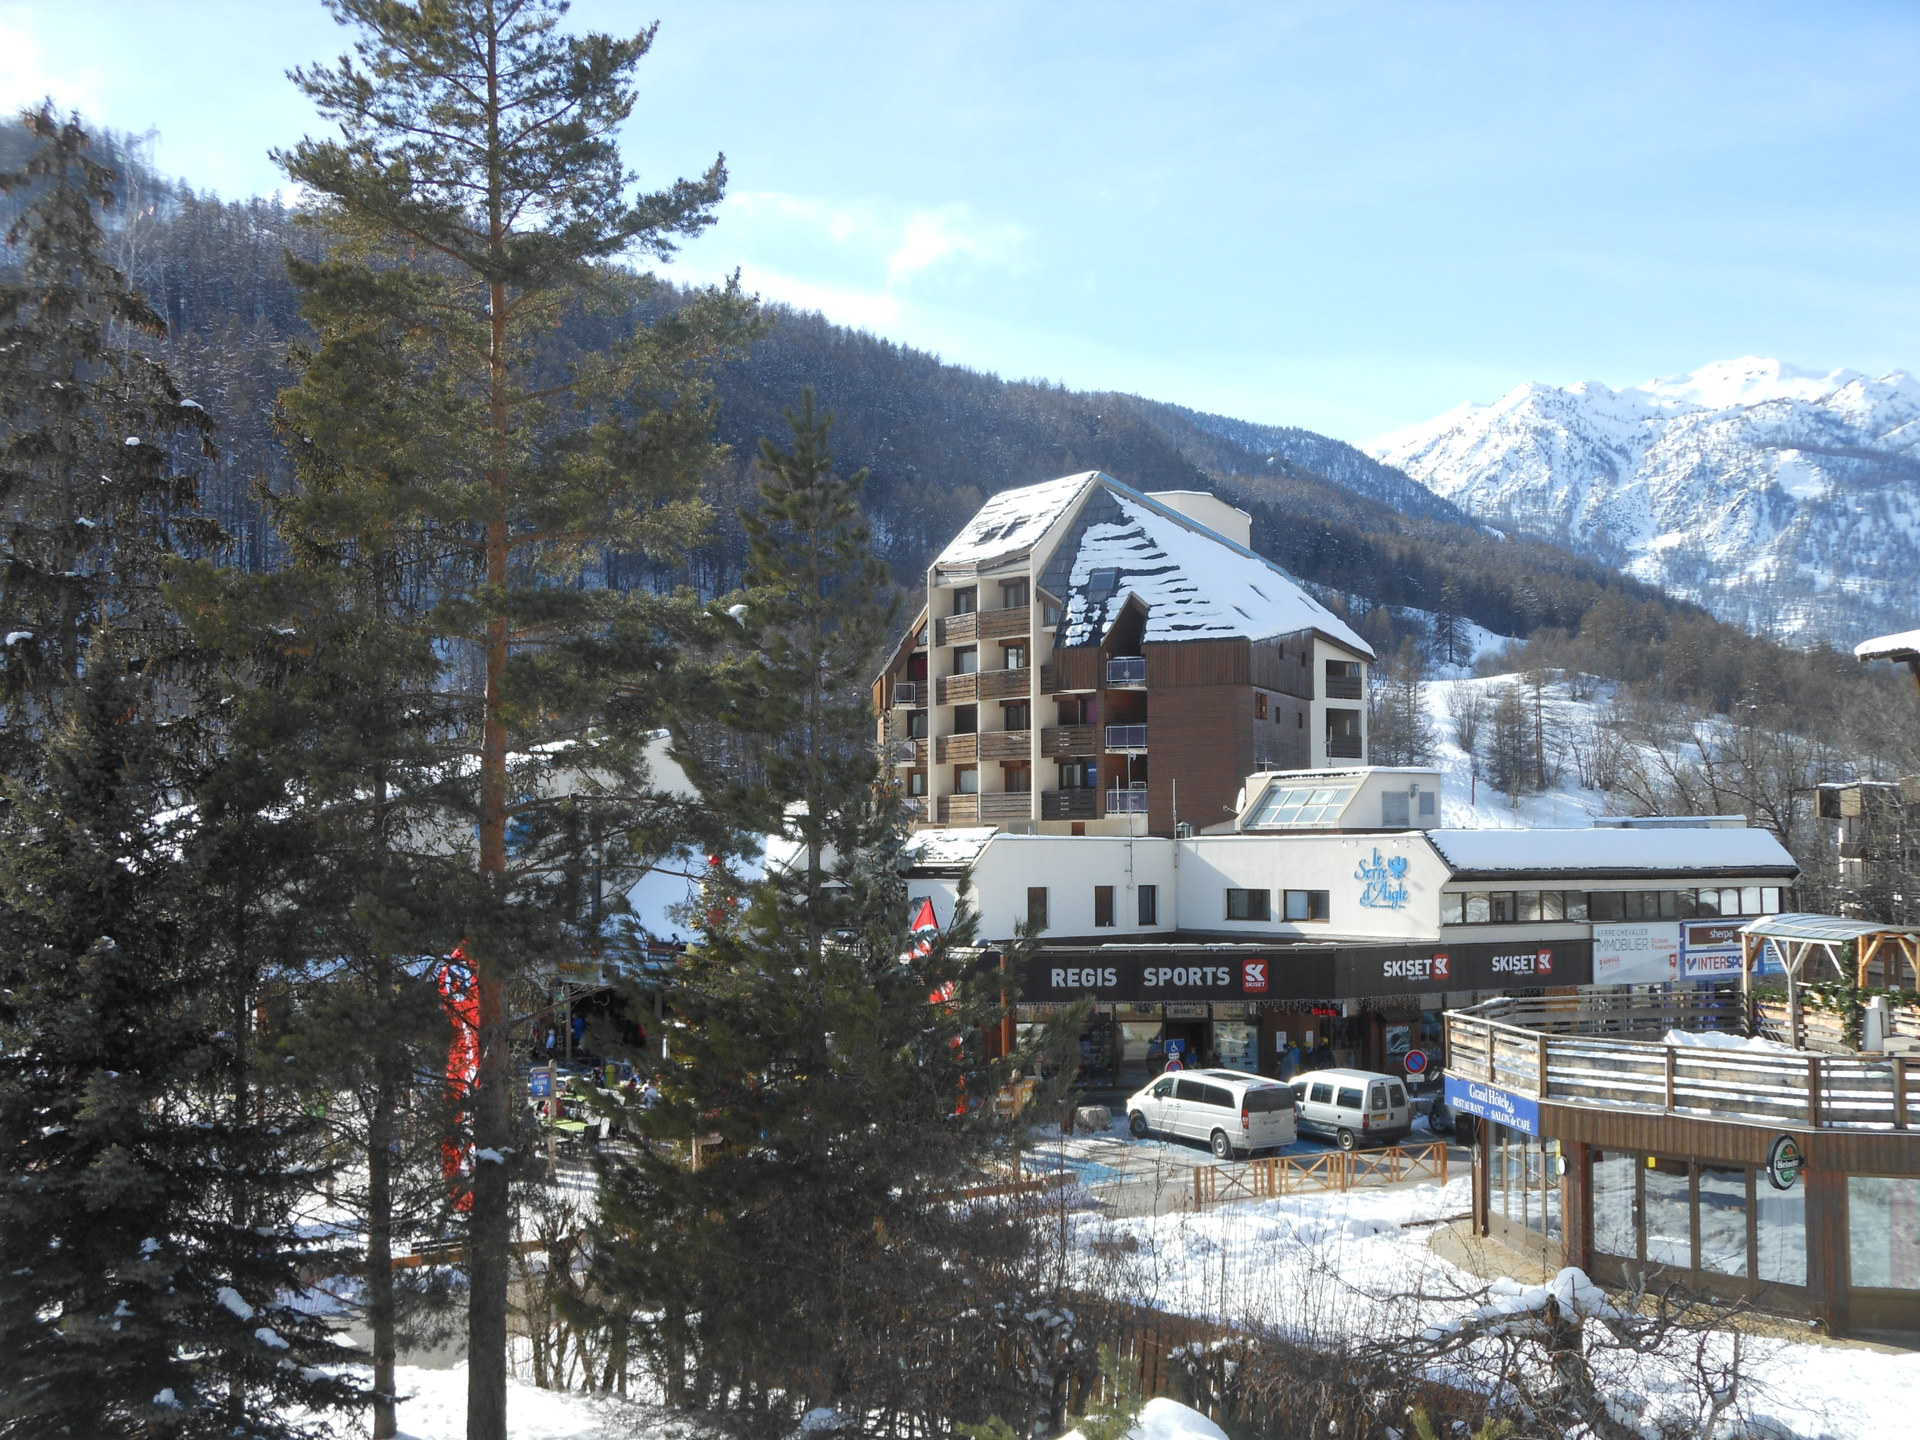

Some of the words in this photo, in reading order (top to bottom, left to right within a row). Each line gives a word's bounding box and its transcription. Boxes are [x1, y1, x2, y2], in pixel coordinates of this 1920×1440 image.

[1383, 959, 1432, 977] SKISET
[1492, 954, 1536, 972] SKISET
[1698, 955, 1744, 971] INTERSPO
[1051, 968, 1117, 987] REGIS
[1143, 967, 1231, 986] SPORTS
[1469, 1083, 1488, 1103] Grand
[1491, 1109, 1510, 1124] SALON
